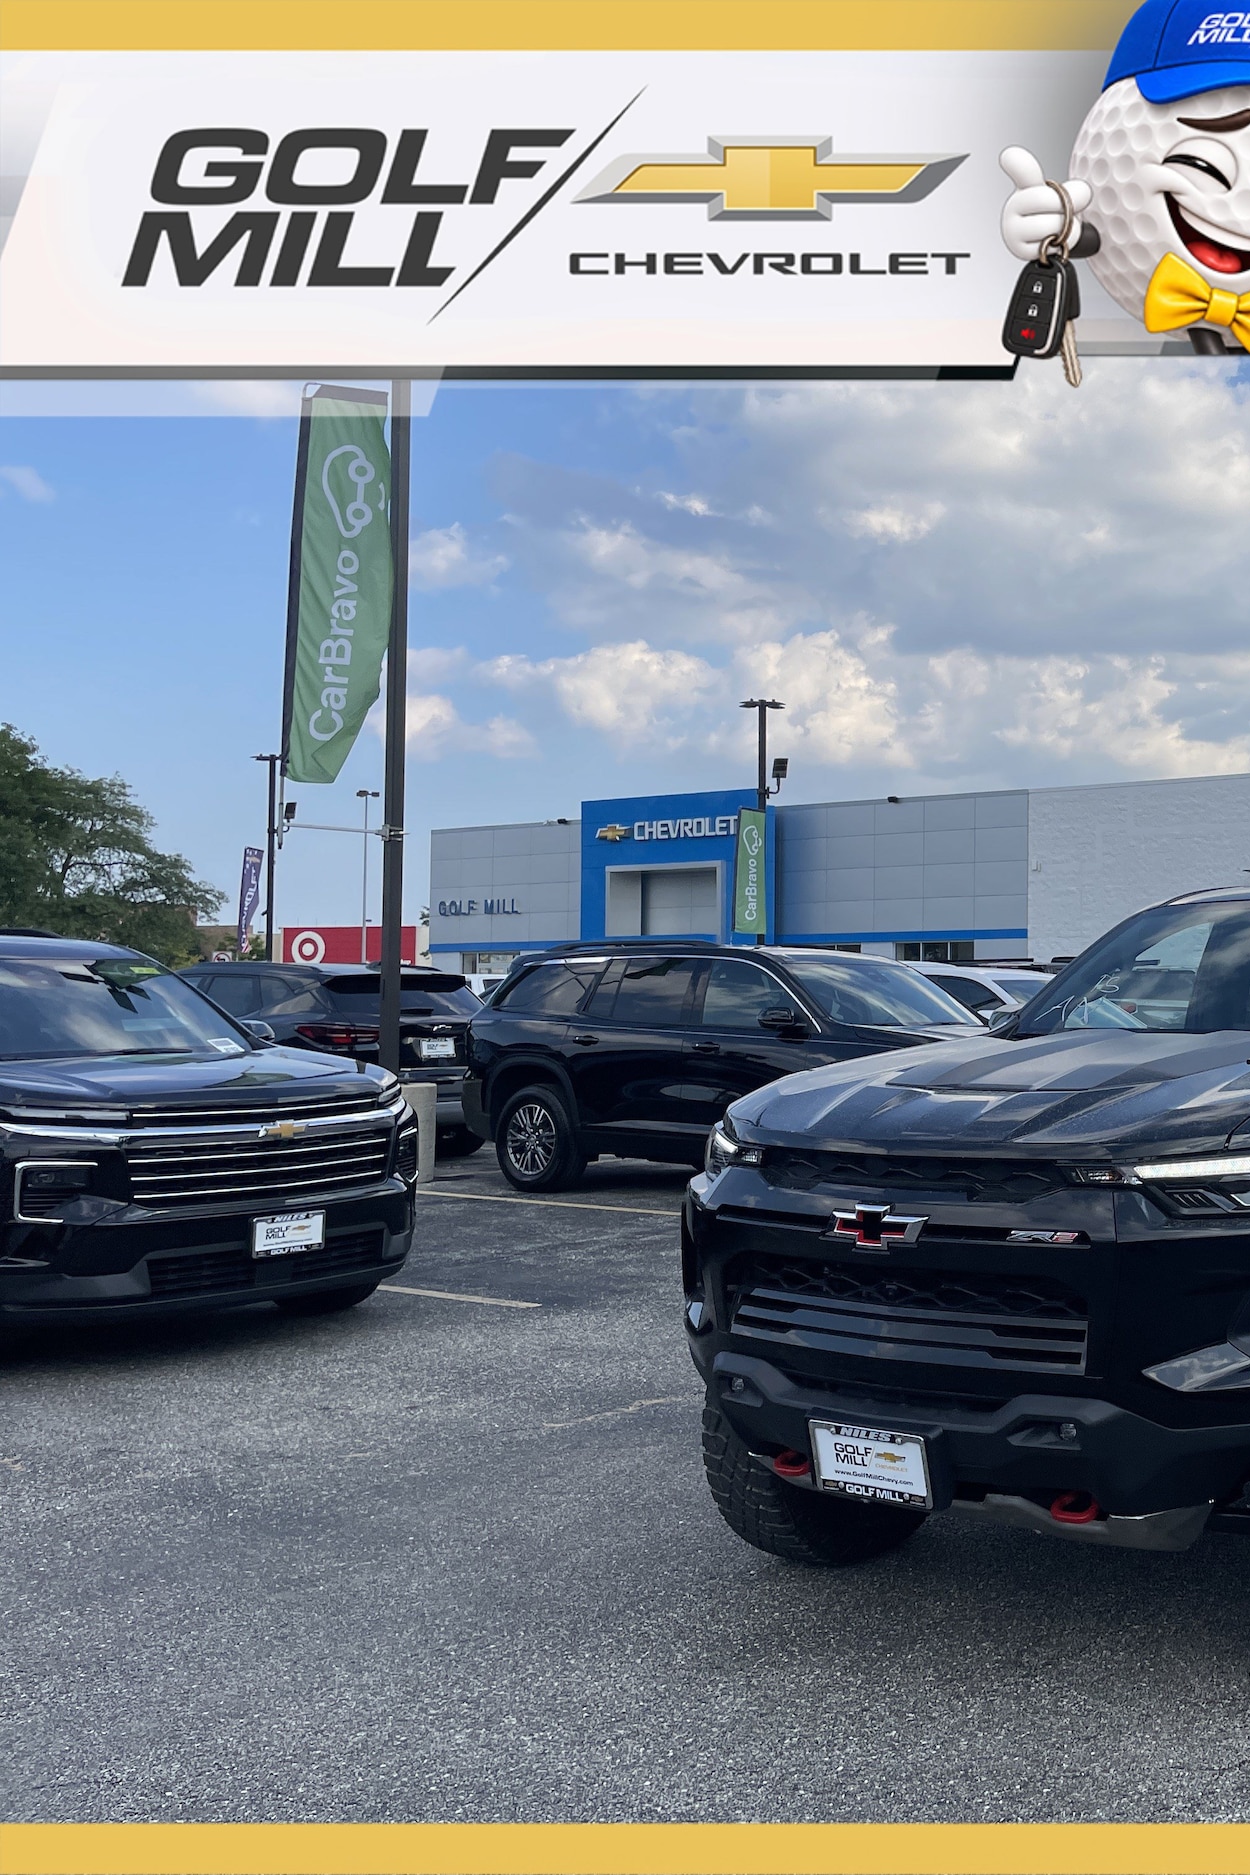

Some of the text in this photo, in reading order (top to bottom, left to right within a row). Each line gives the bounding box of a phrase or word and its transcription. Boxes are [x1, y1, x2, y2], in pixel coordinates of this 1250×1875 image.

[308, 549, 360, 742] CarBravo
[633, 815, 738, 841] CHEVROLET
[744, 858, 757, 920] CarBravo
[438, 898, 521, 917] GOLF MILL
[266, 1226, 290, 1234] GOLF
[840, 1427, 891, 1441] NILES
[833, 1442, 873, 1457] GOLF
[835, 1453, 868, 1467] MILL
[845, 1483, 875, 1497] GOLF
[876, 1489, 903, 1502] MILL
